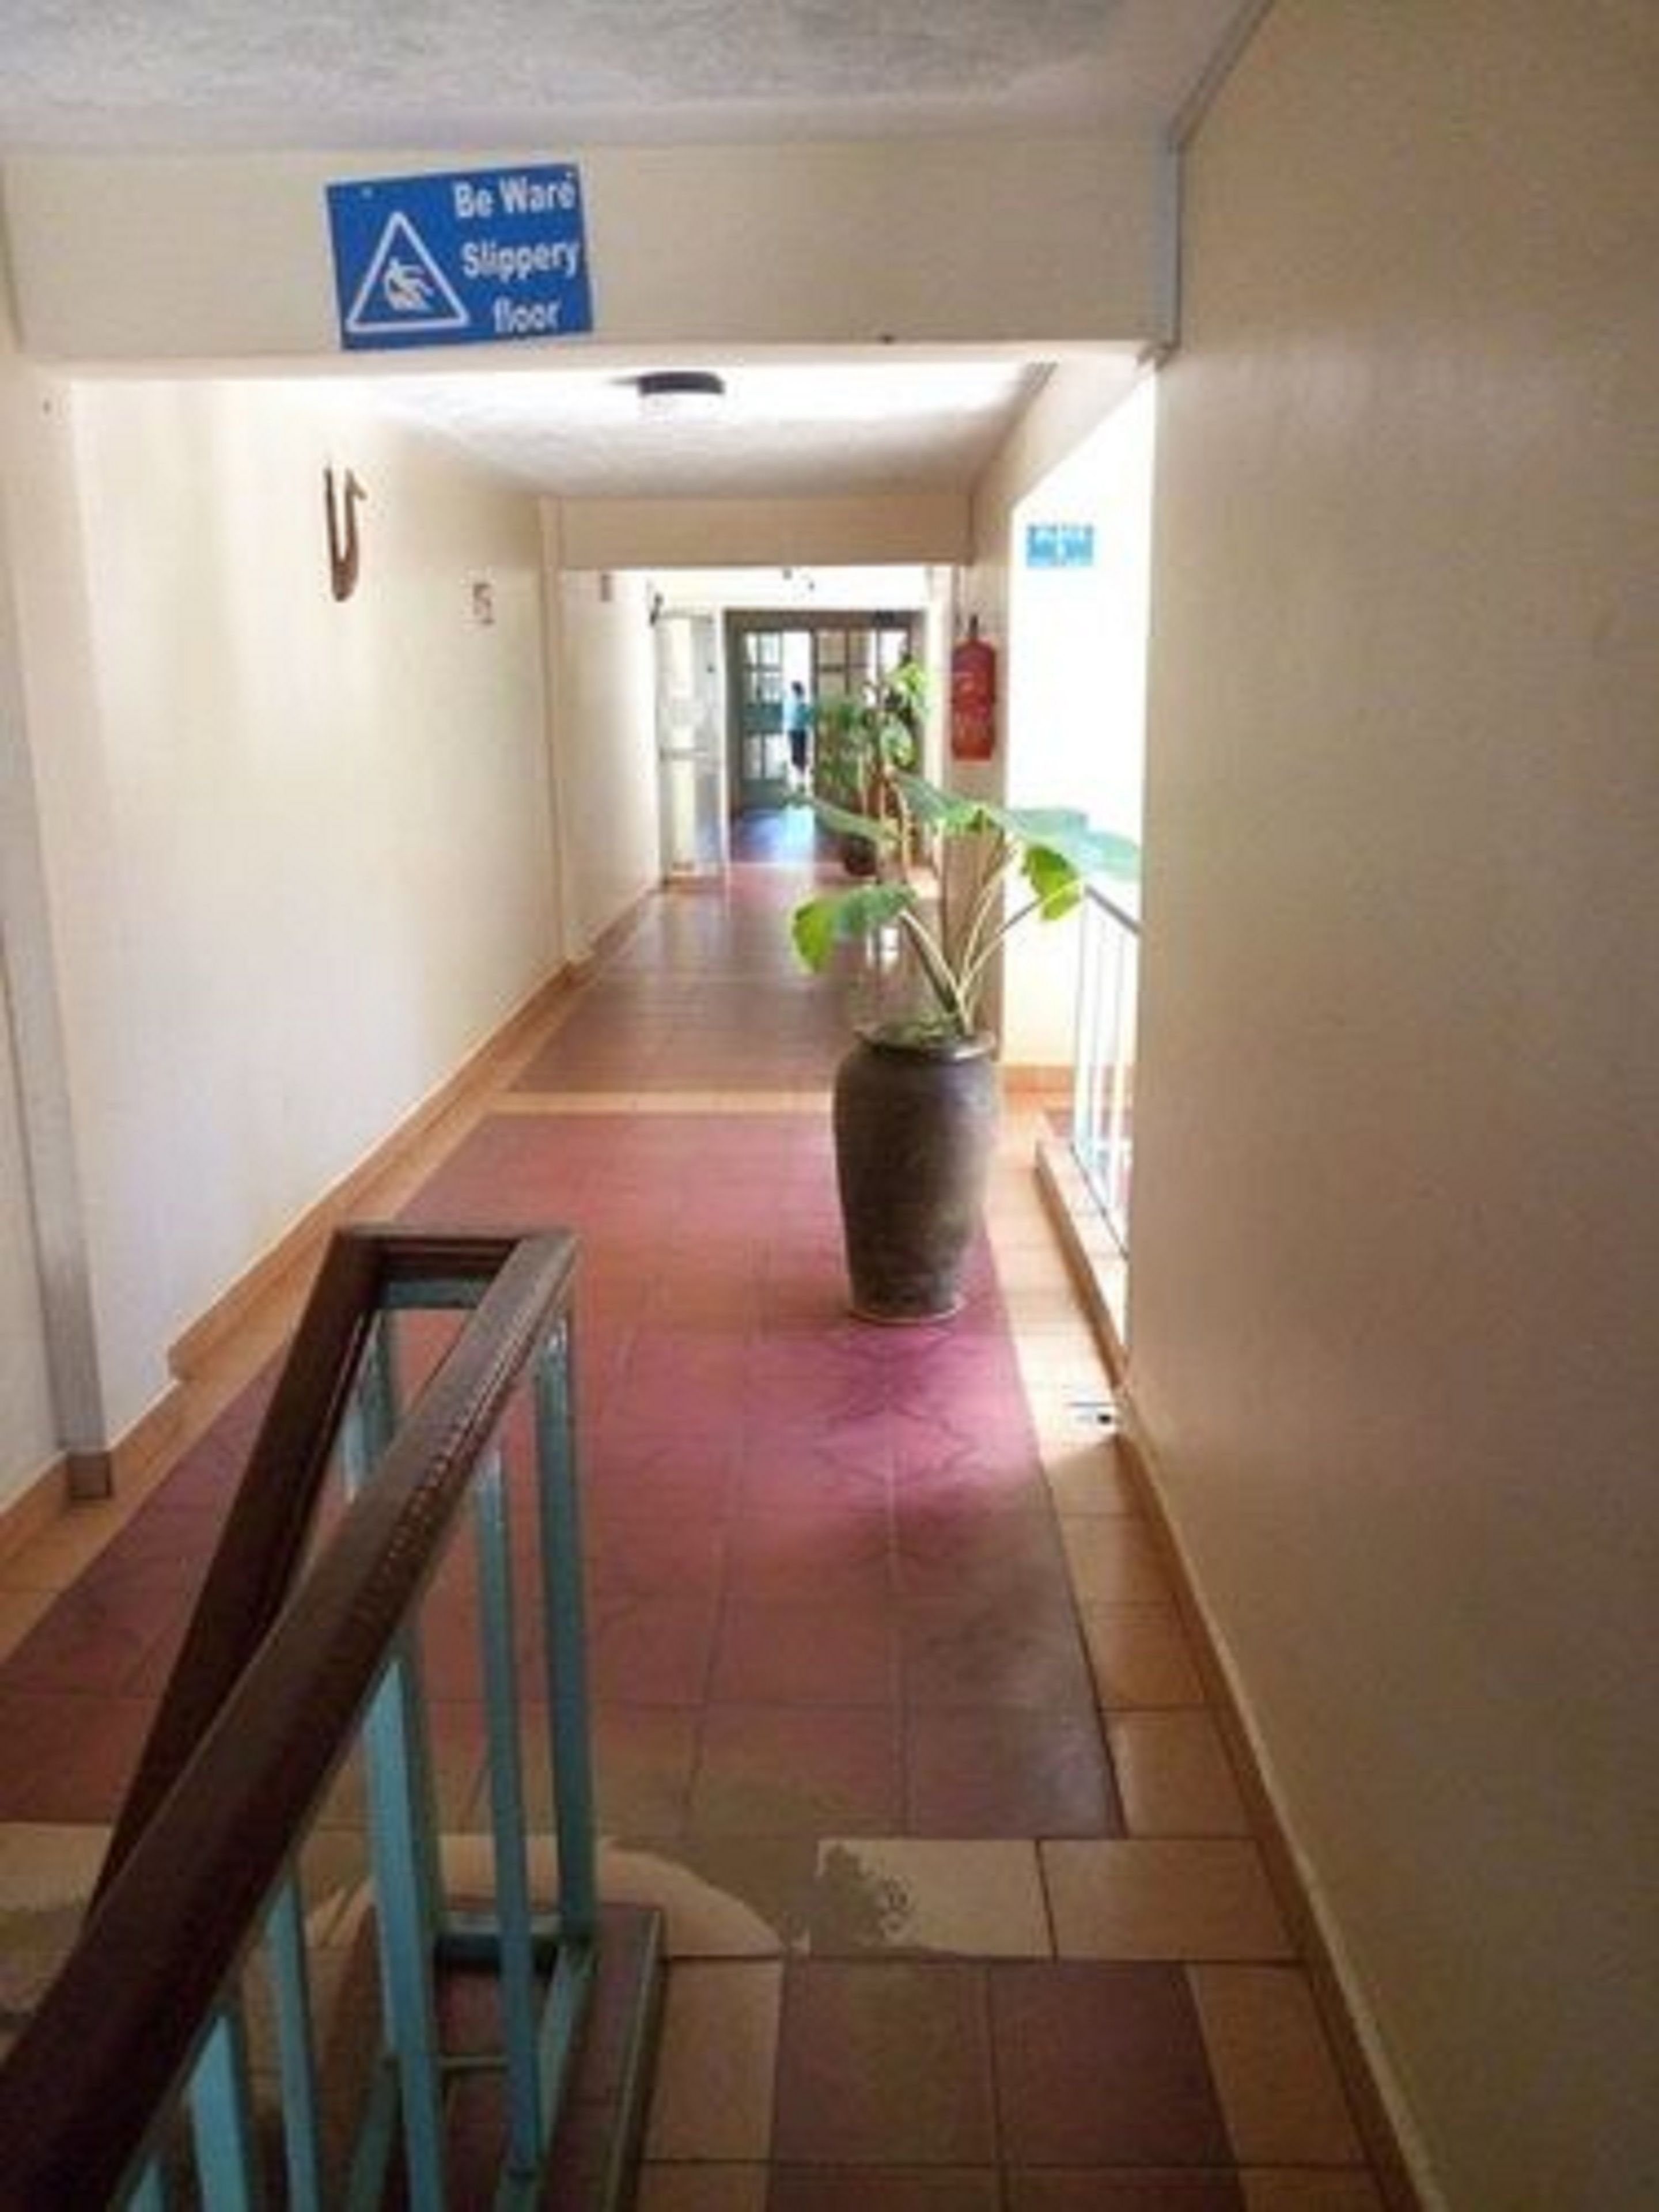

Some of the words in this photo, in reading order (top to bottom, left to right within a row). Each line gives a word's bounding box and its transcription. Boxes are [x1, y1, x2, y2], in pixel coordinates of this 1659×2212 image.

[453, 181, 494, 218] Be
[499, 177, 575, 214] Ware
[463, 240, 580, 282] Slippery
[494, 296, 561, 333] floor
